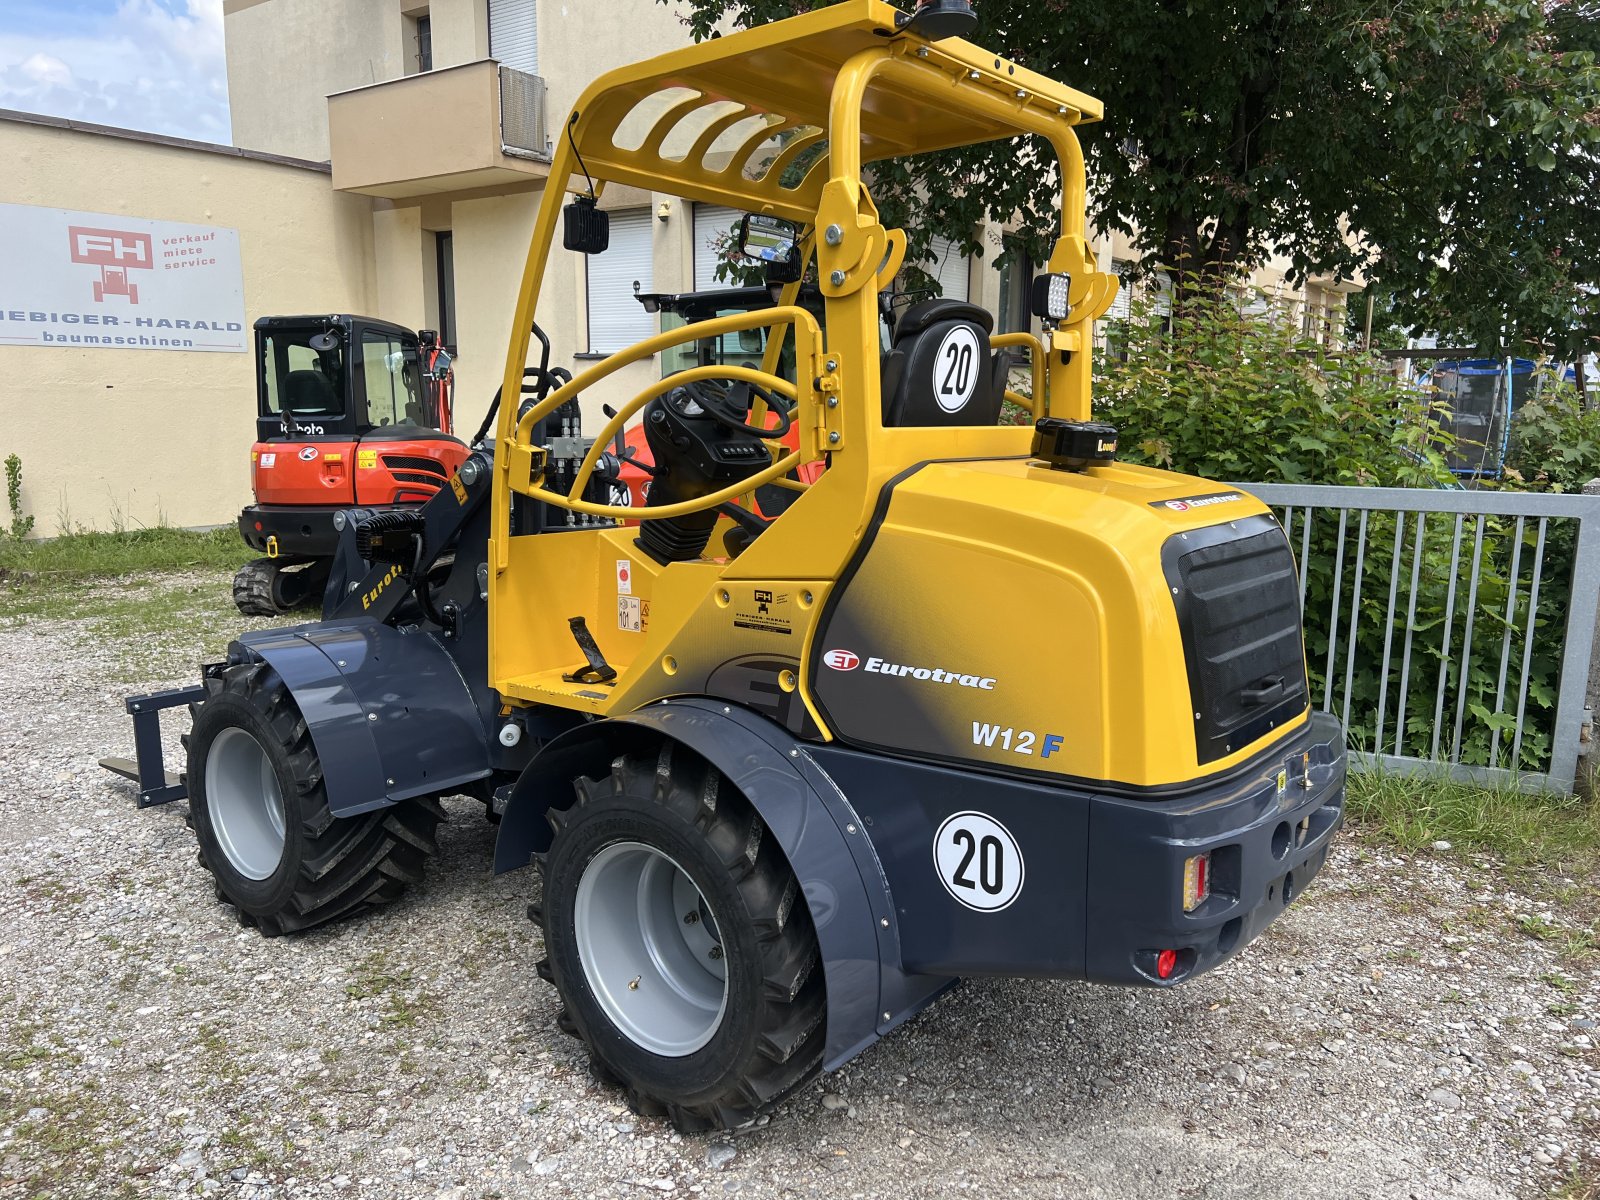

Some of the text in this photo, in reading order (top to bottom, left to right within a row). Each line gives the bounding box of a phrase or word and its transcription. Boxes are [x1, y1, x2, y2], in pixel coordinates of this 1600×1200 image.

[162, 231, 216, 246] verkauf
[76, 232, 148, 263] FH
[163, 246, 204, 258] miete
[164, 258, 217, 270] service
[42, 331, 194, 347] baumaschinen
[940, 342, 972, 396] 20
[280, 423, 325, 435] Kbota
[755, 591, 771, 602] FH
[619, 610, 629, 628] 101
[828, 650, 997, 690] ET Eurotrac
[971, 721, 1065, 758] W12 F
[952, 828, 1004, 896] 20
